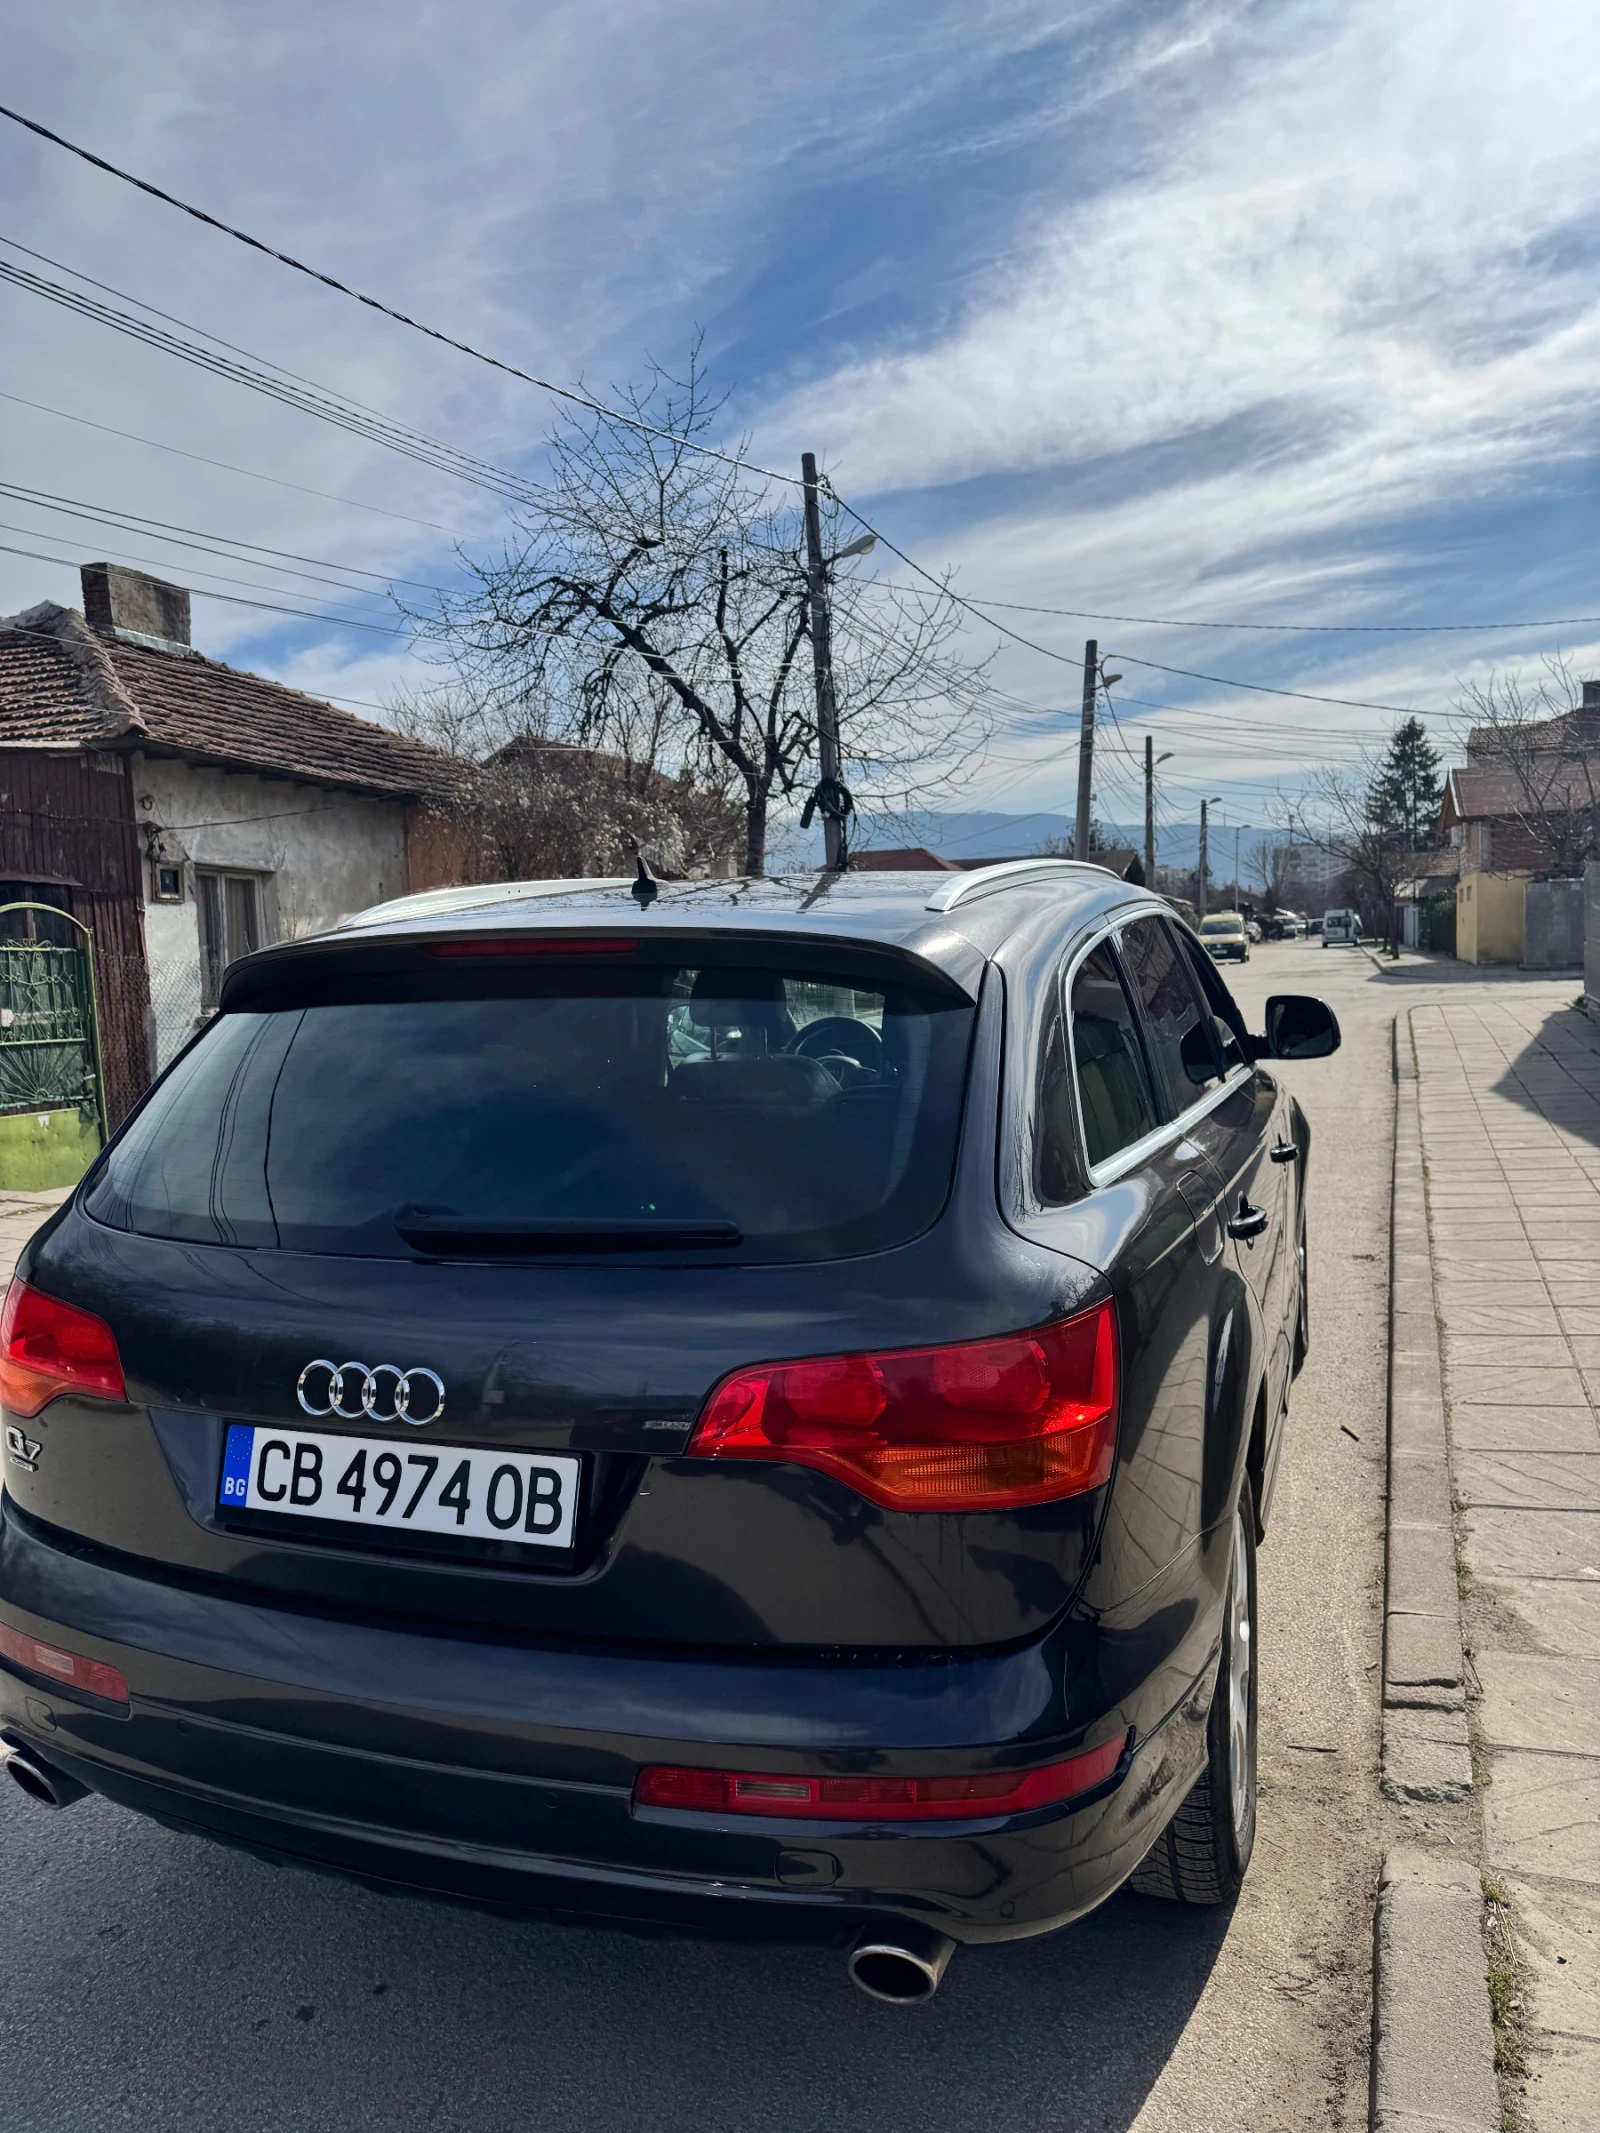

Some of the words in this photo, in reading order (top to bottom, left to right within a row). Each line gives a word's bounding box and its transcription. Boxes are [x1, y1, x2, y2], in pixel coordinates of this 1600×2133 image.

[6, 1426, 40, 1460] Q7
[224, 1477, 246, 1497] BG
[257, 1440, 323, 1506] CB
[336, 1449, 471, 1525] 4974
